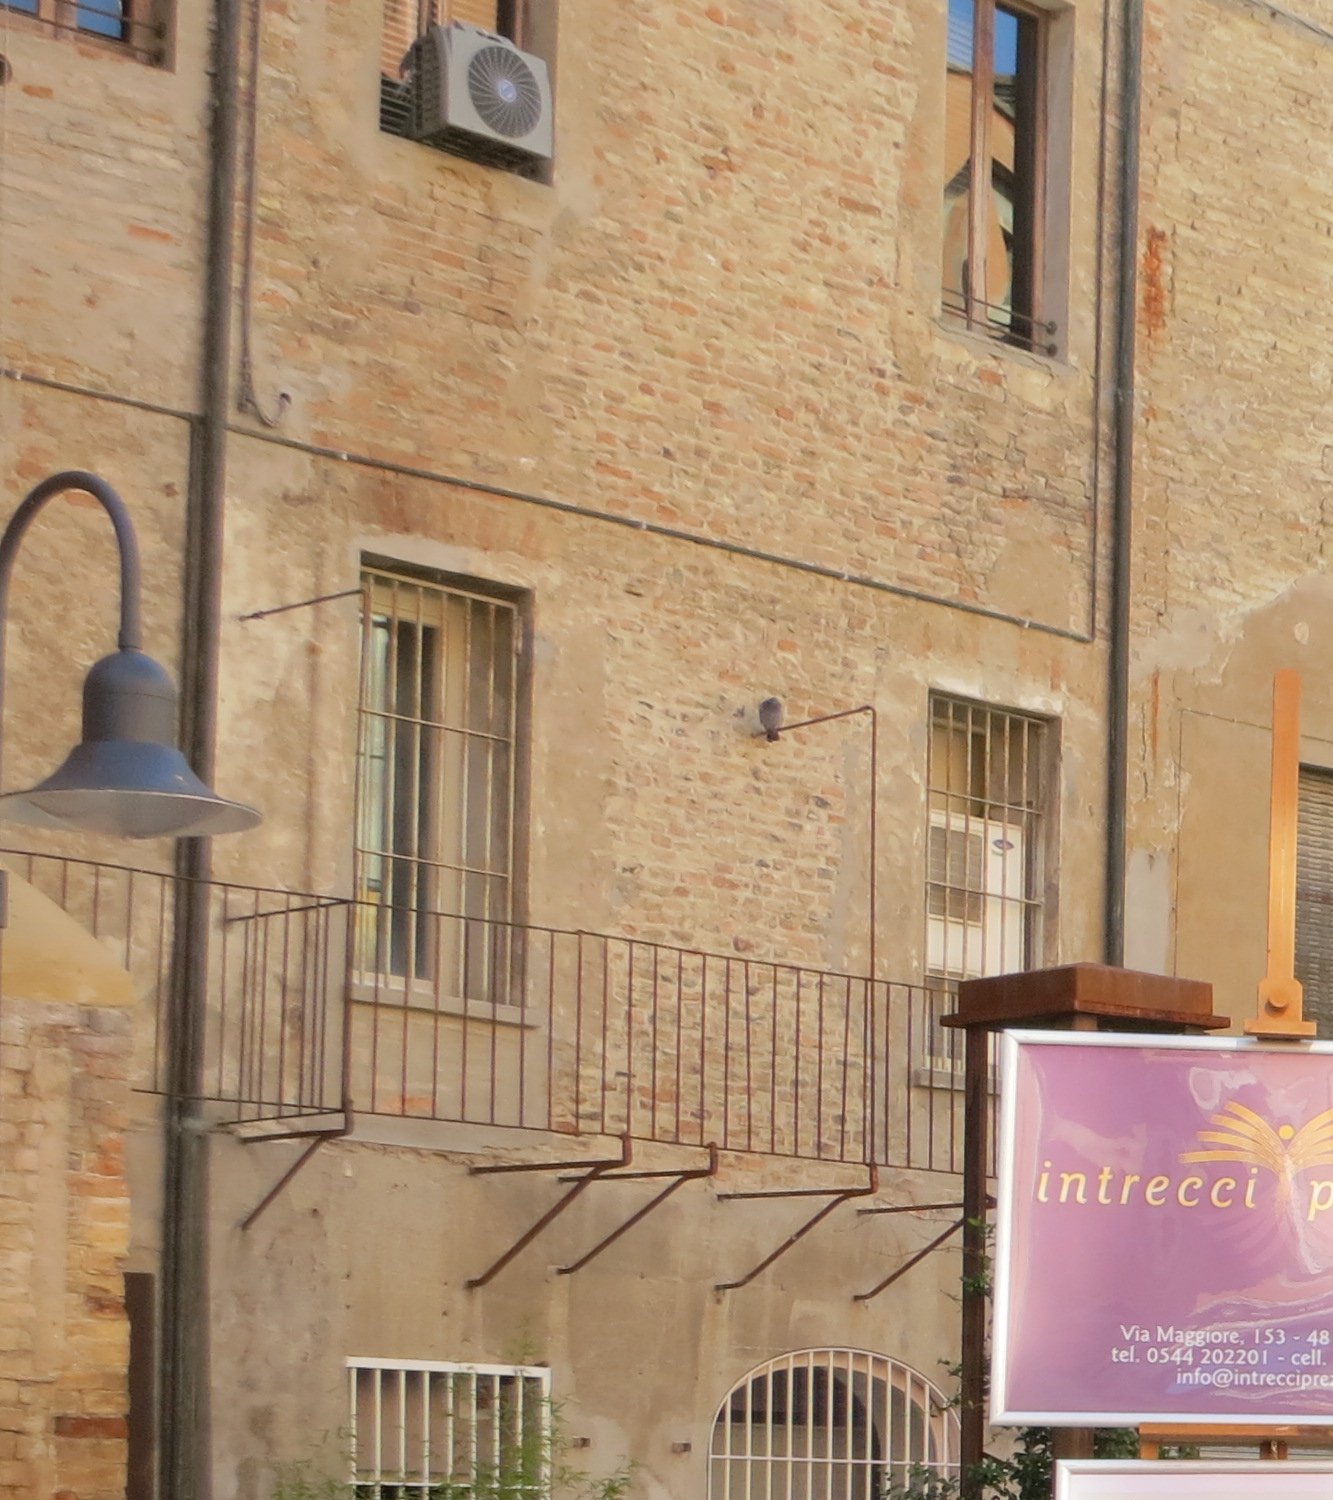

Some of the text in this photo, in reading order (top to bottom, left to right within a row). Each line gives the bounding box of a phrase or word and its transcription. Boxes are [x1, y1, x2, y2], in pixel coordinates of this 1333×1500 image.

[1037, 1160, 1258, 1209] intrecci
[1120, 1325, 1150, 1342] Via
[1157, 1326, 1245, 1346] Maggiore,
[1254, 1329, 1286, 1344] 153
[1111, 1347, 1139, 1363] tel.
[1147, 1348, 1194, 1365] 0544
[1200, 1349, 1268, 1365] 202201
[1291, 1350, 1326, 1367] cell.
